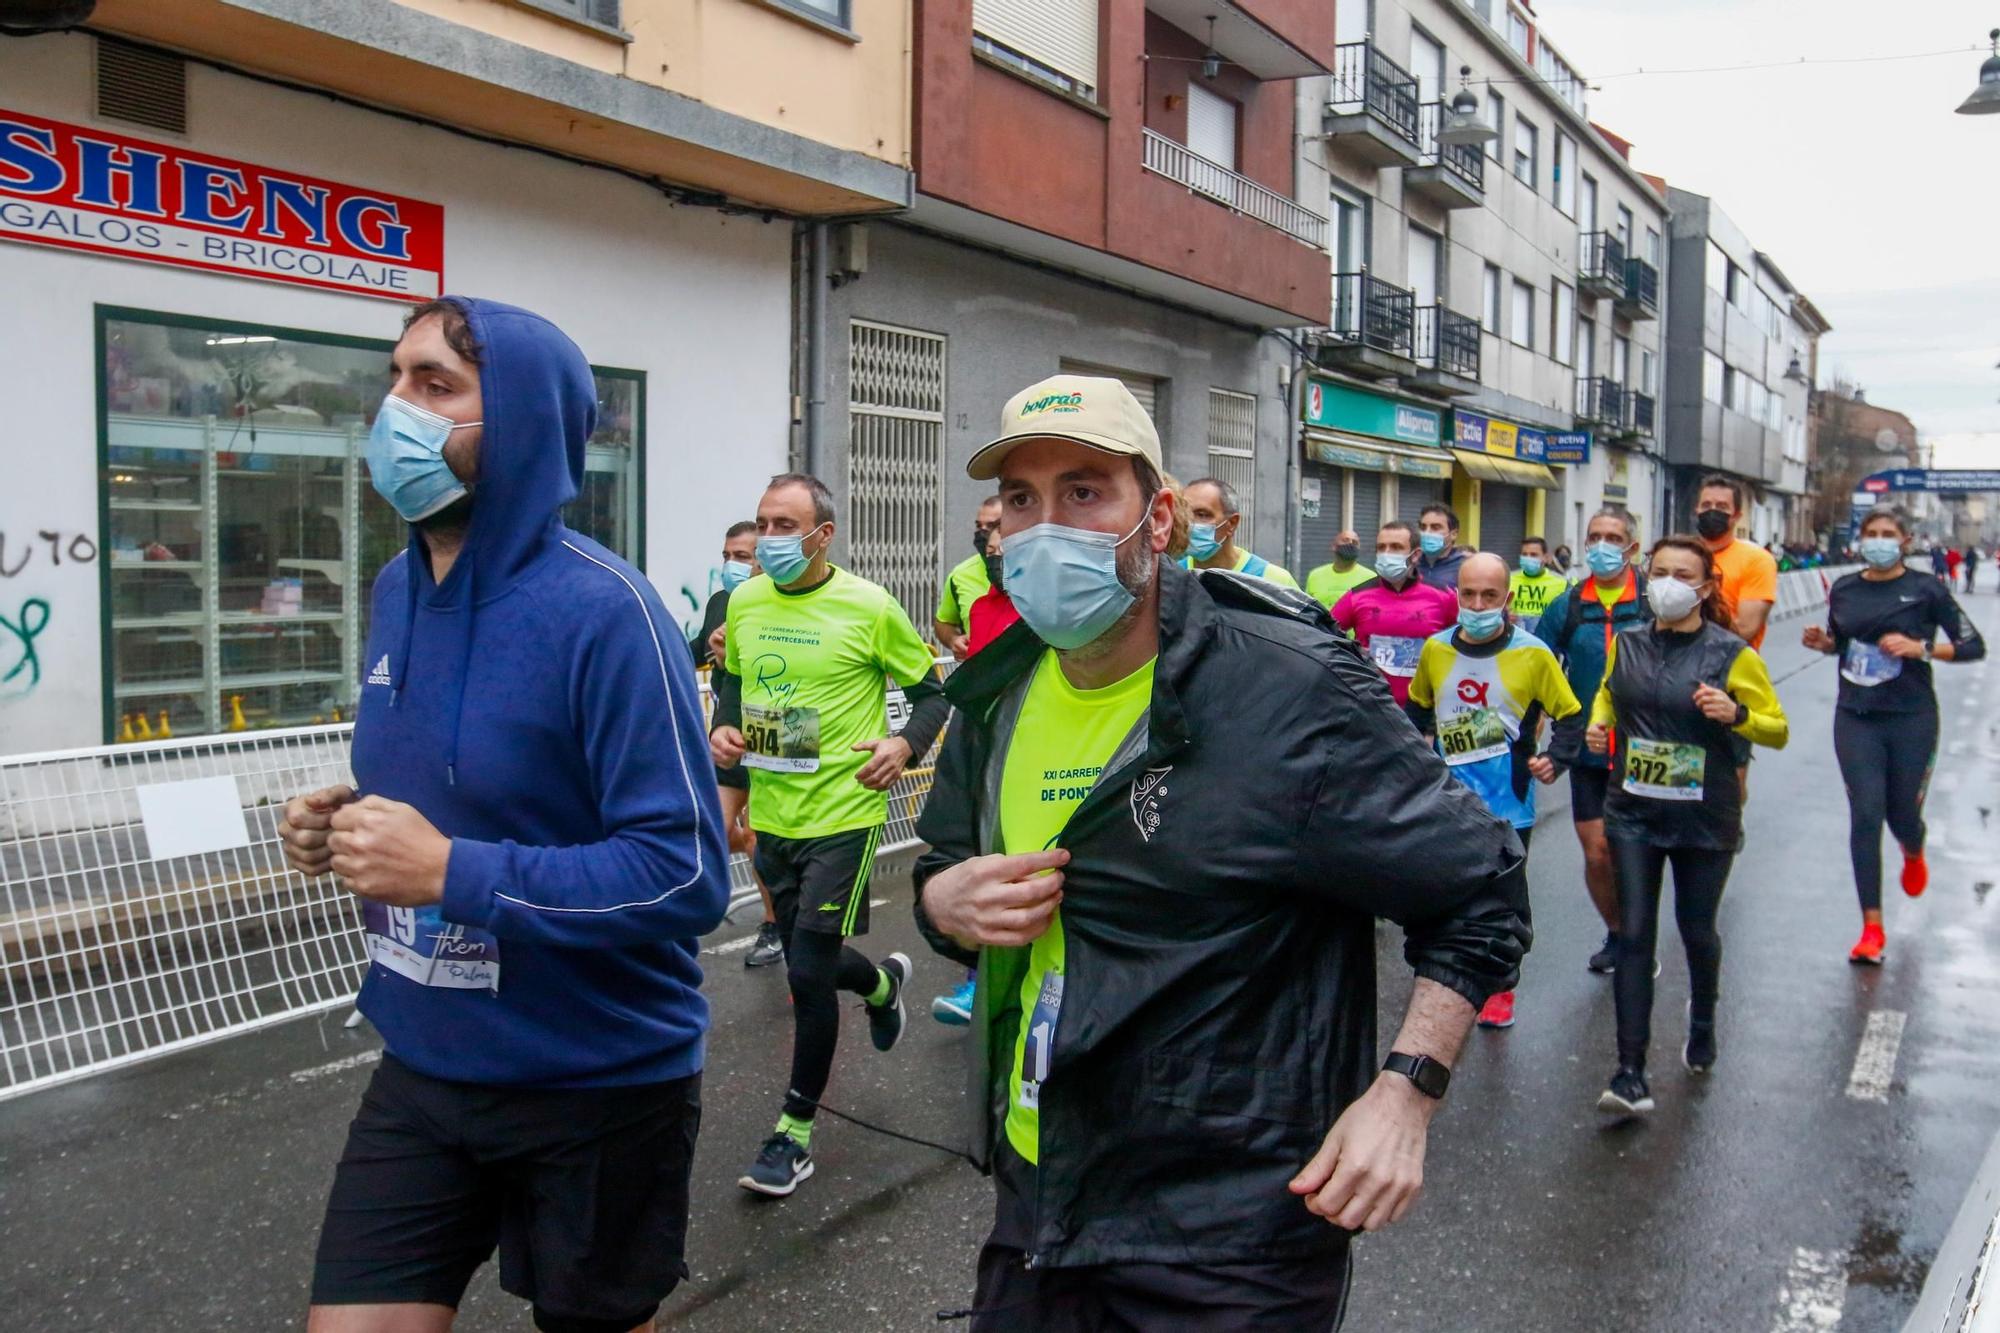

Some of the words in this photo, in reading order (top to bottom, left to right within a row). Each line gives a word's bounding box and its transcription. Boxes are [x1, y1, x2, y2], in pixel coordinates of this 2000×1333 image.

[0, 120, 411, 260] SHENG
[204, 236, 409, 290] BRICOLAJE
[1558, 434, 1586, 445] activa
[1375, 647, 1396, 667] 52
[746, 723, 780, 756] 374
[1443, 728, 1477, 755] 361
[1043, 770, 1057, 780] XXI
[1630, 756, 1668, 786] 372
[1041, 789, 1056, 801] DE
